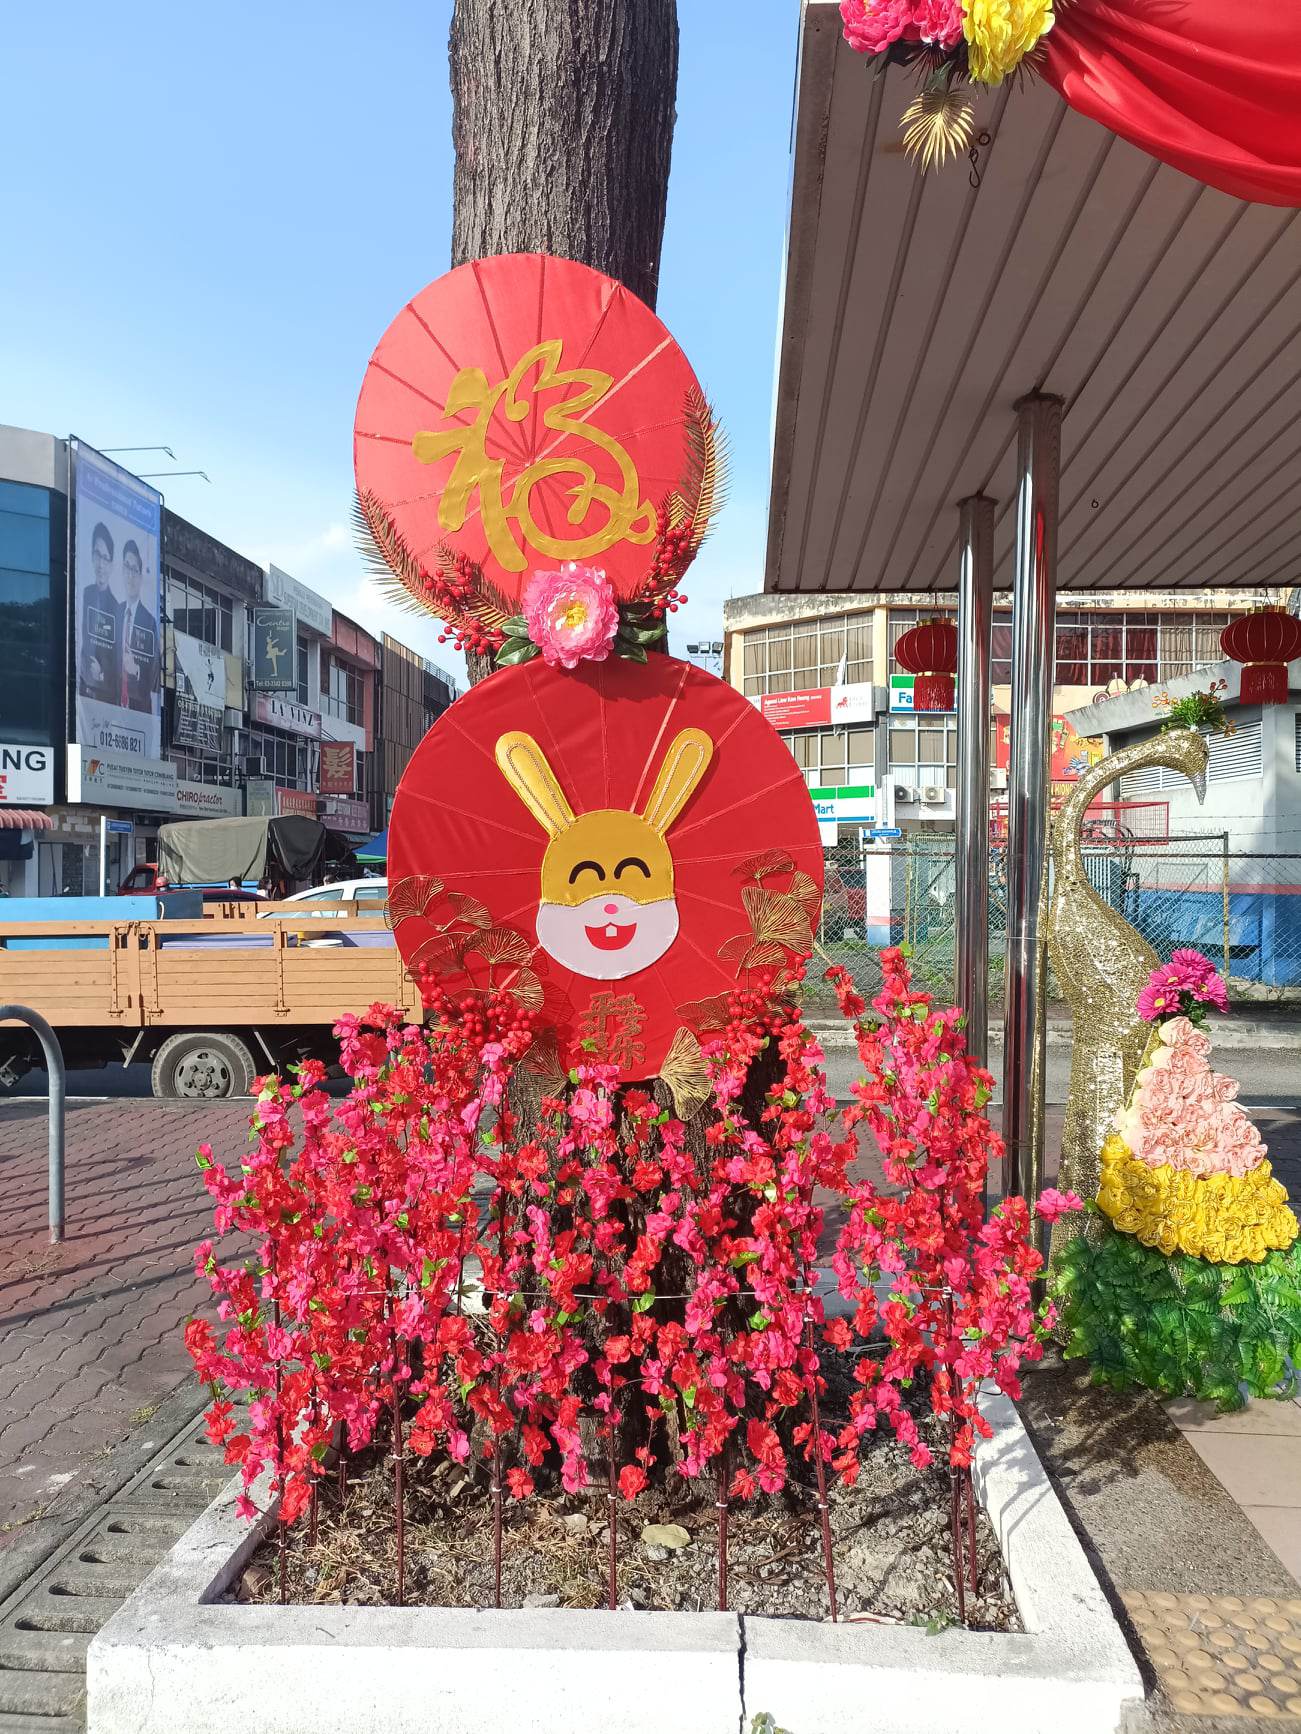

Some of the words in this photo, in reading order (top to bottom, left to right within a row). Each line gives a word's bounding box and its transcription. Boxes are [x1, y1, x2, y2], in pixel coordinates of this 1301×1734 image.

[411, 339, 658, 573] 福
[272, 699, 284, 717] LA
[814, 803, 834, 814] Mart
